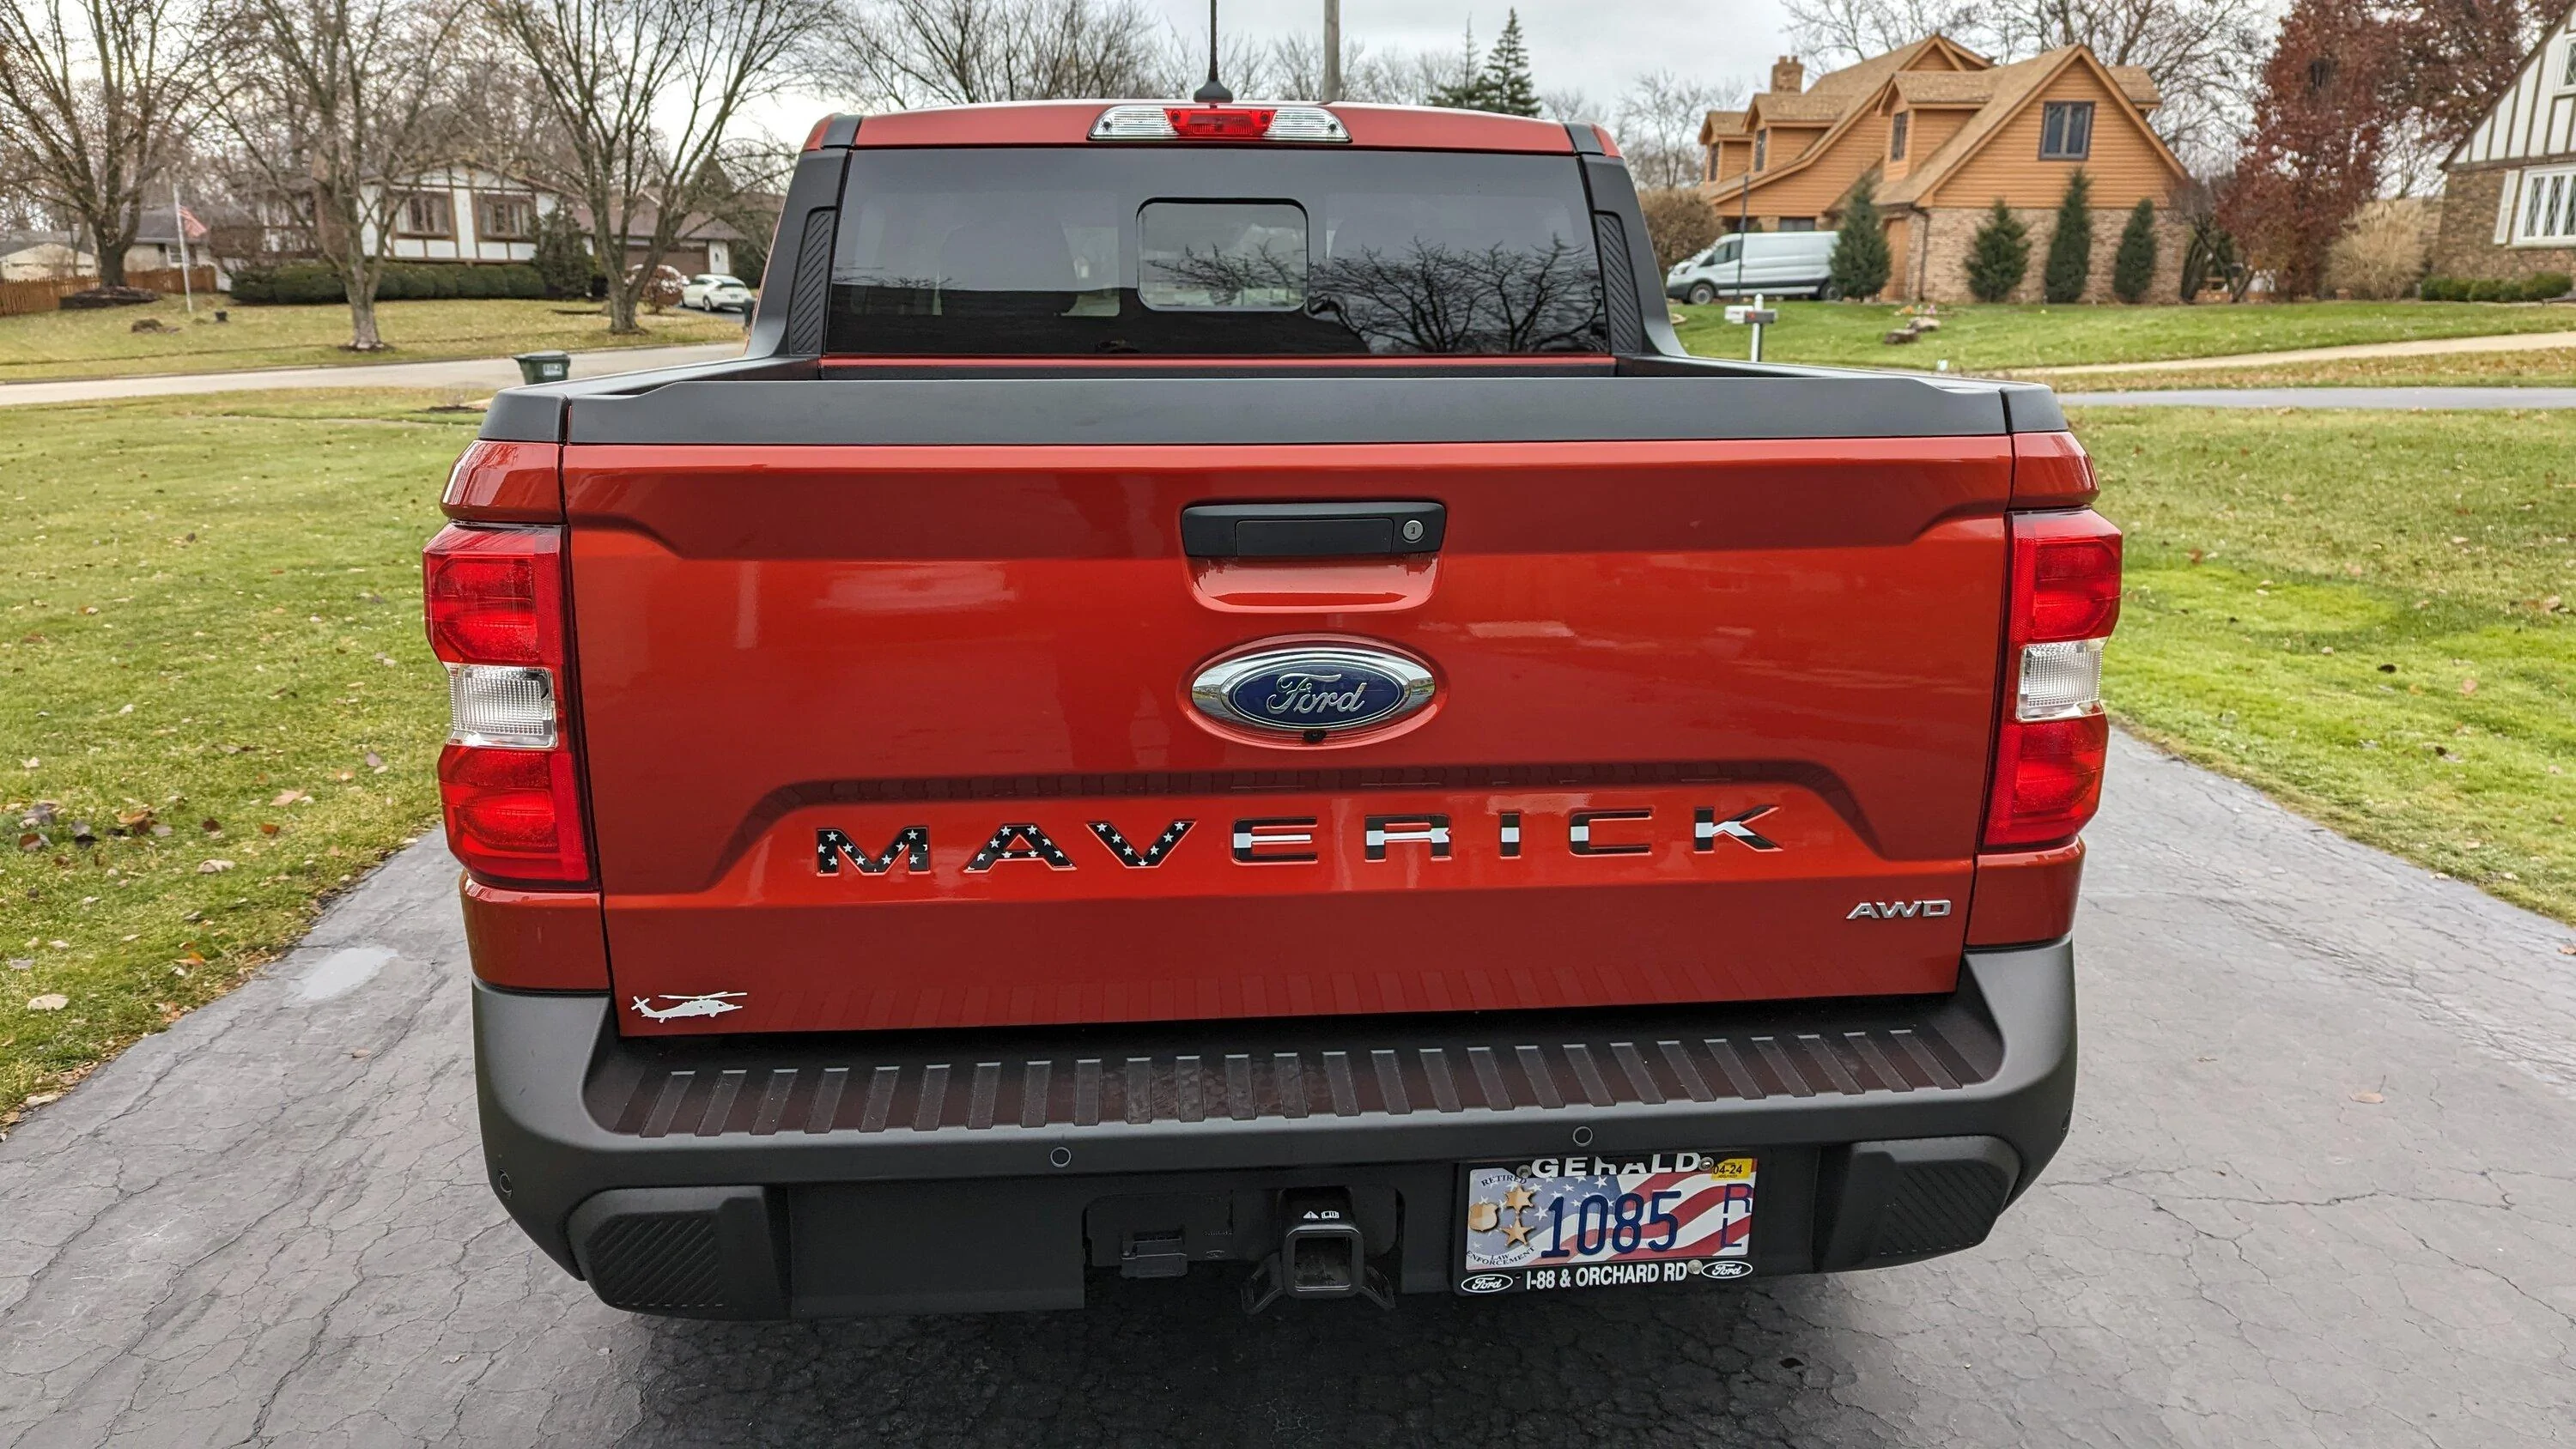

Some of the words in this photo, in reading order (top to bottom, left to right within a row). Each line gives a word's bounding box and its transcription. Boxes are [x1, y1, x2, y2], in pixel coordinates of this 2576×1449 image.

[1266, 672, 1367, 713] Ford
[815, 805, 1783, 875] MAVERICK
[1845, 899, 1952, 919] AWD
[1712, 1164, 1743, 1174] 04-24
[1481, 1174, 1528, 1186] RETIRED
[1541, 1190, 1682, 1258] 1085
[1467, 1246, 1535, 1266] ENFORCEMENT
[1559, 1271, 1571, 1287] &
[1575, 1264, 1659, 1286] ORCHARD
[1662, 1262, 1687, 1282] RD
[1712, 1263, 1741, 1276] Ford
[1472, 1276, 1504, 1290] Ford
